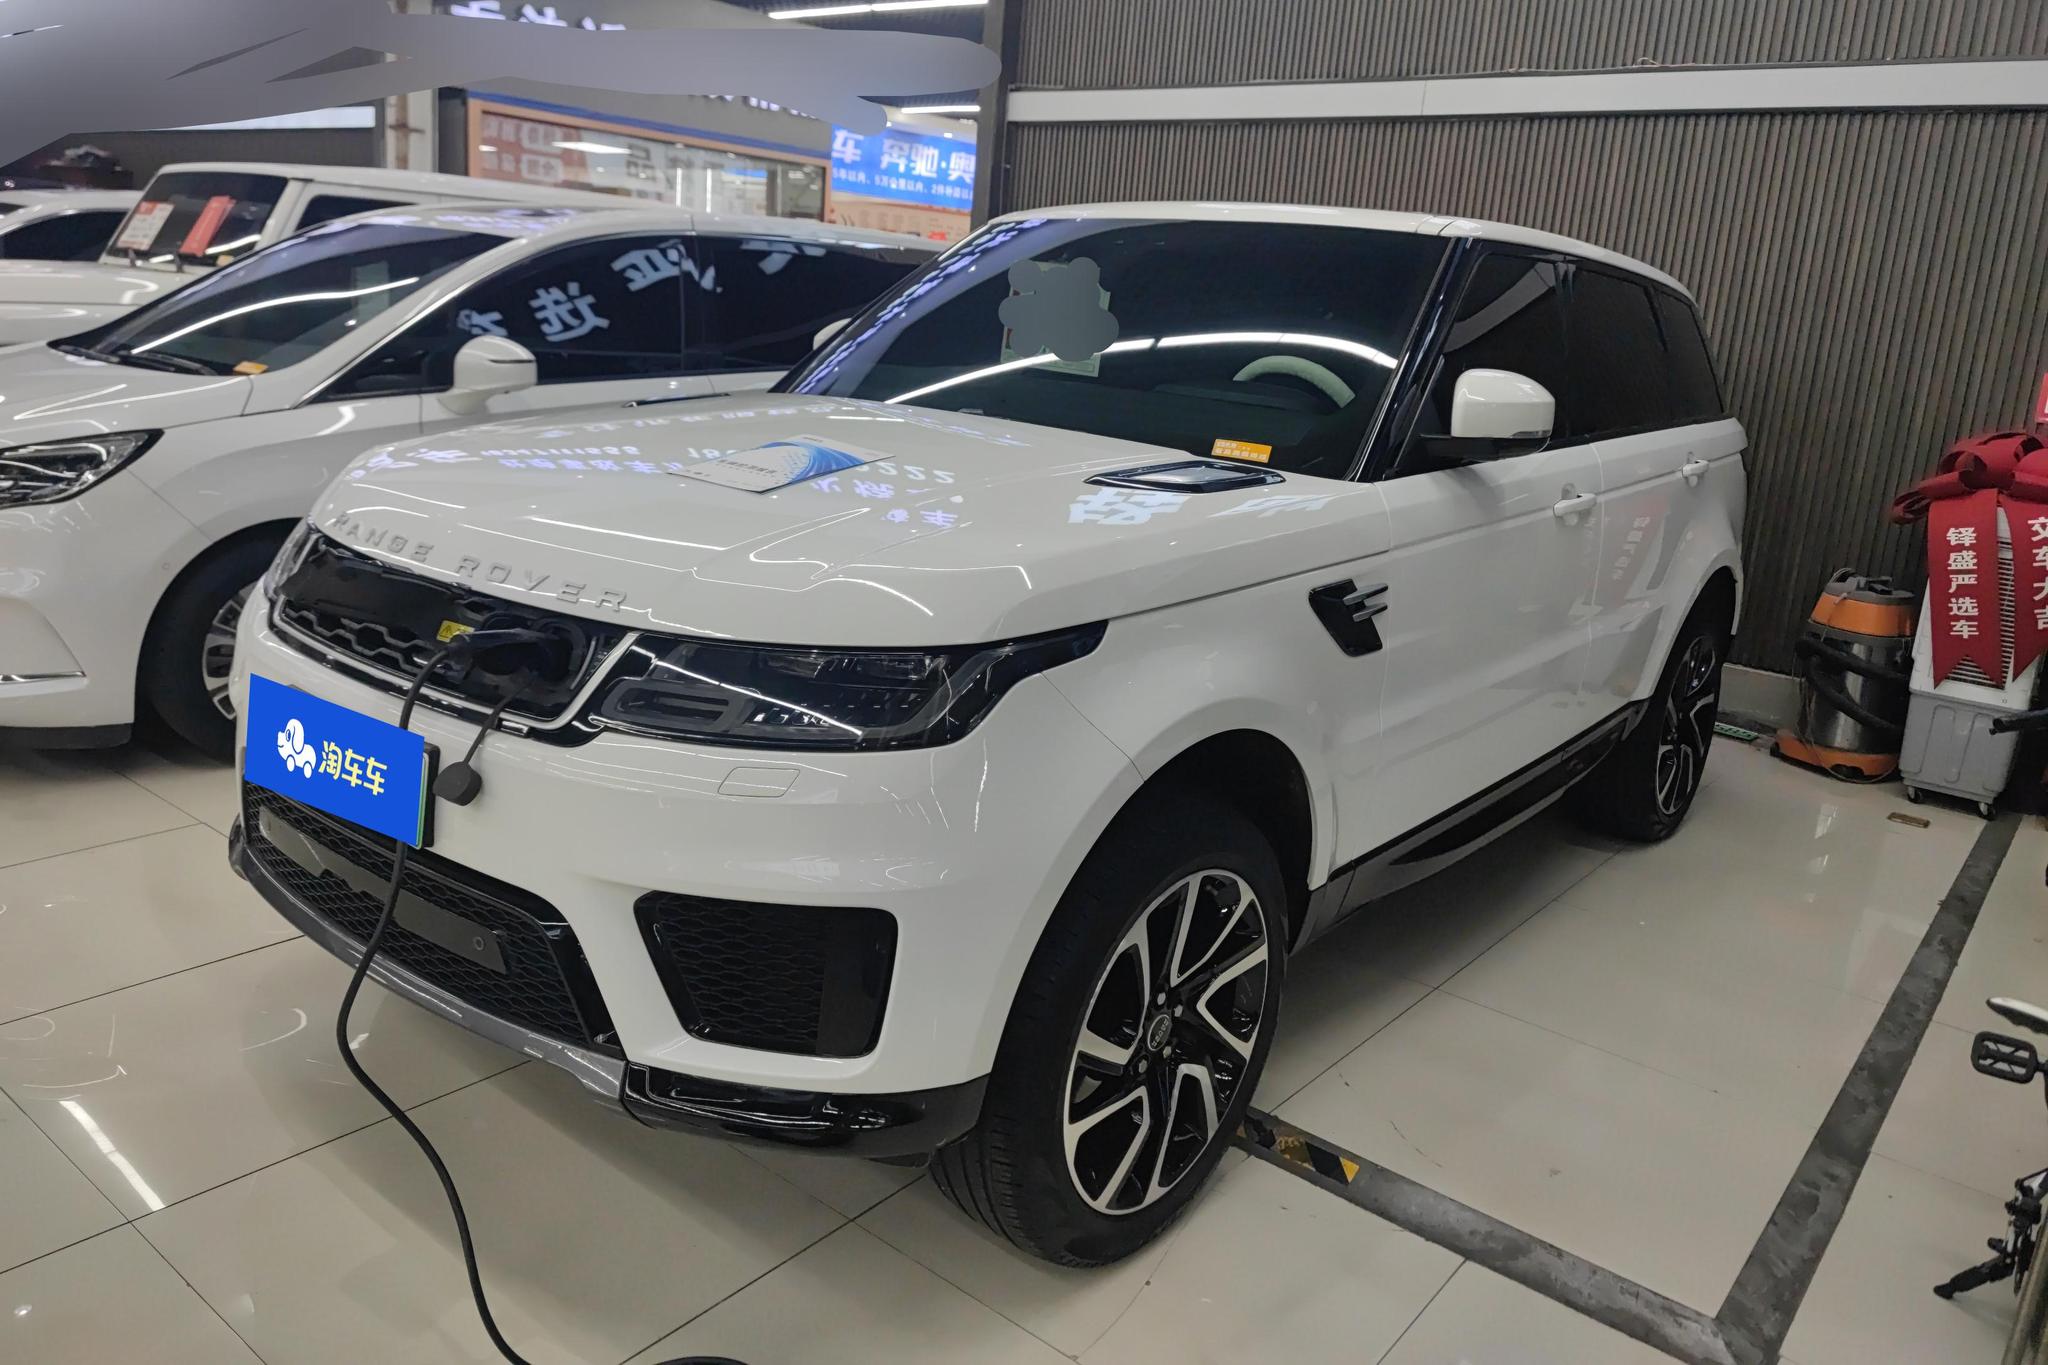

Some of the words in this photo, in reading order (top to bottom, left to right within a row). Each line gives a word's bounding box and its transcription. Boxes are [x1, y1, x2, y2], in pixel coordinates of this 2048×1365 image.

[831, 129, 865, 164] 车
[332, 511, 435, 563] RANGE
[455, 555, 627, 612] ROVER
[1946, 527, 1980, 639] 铎盛严选车
